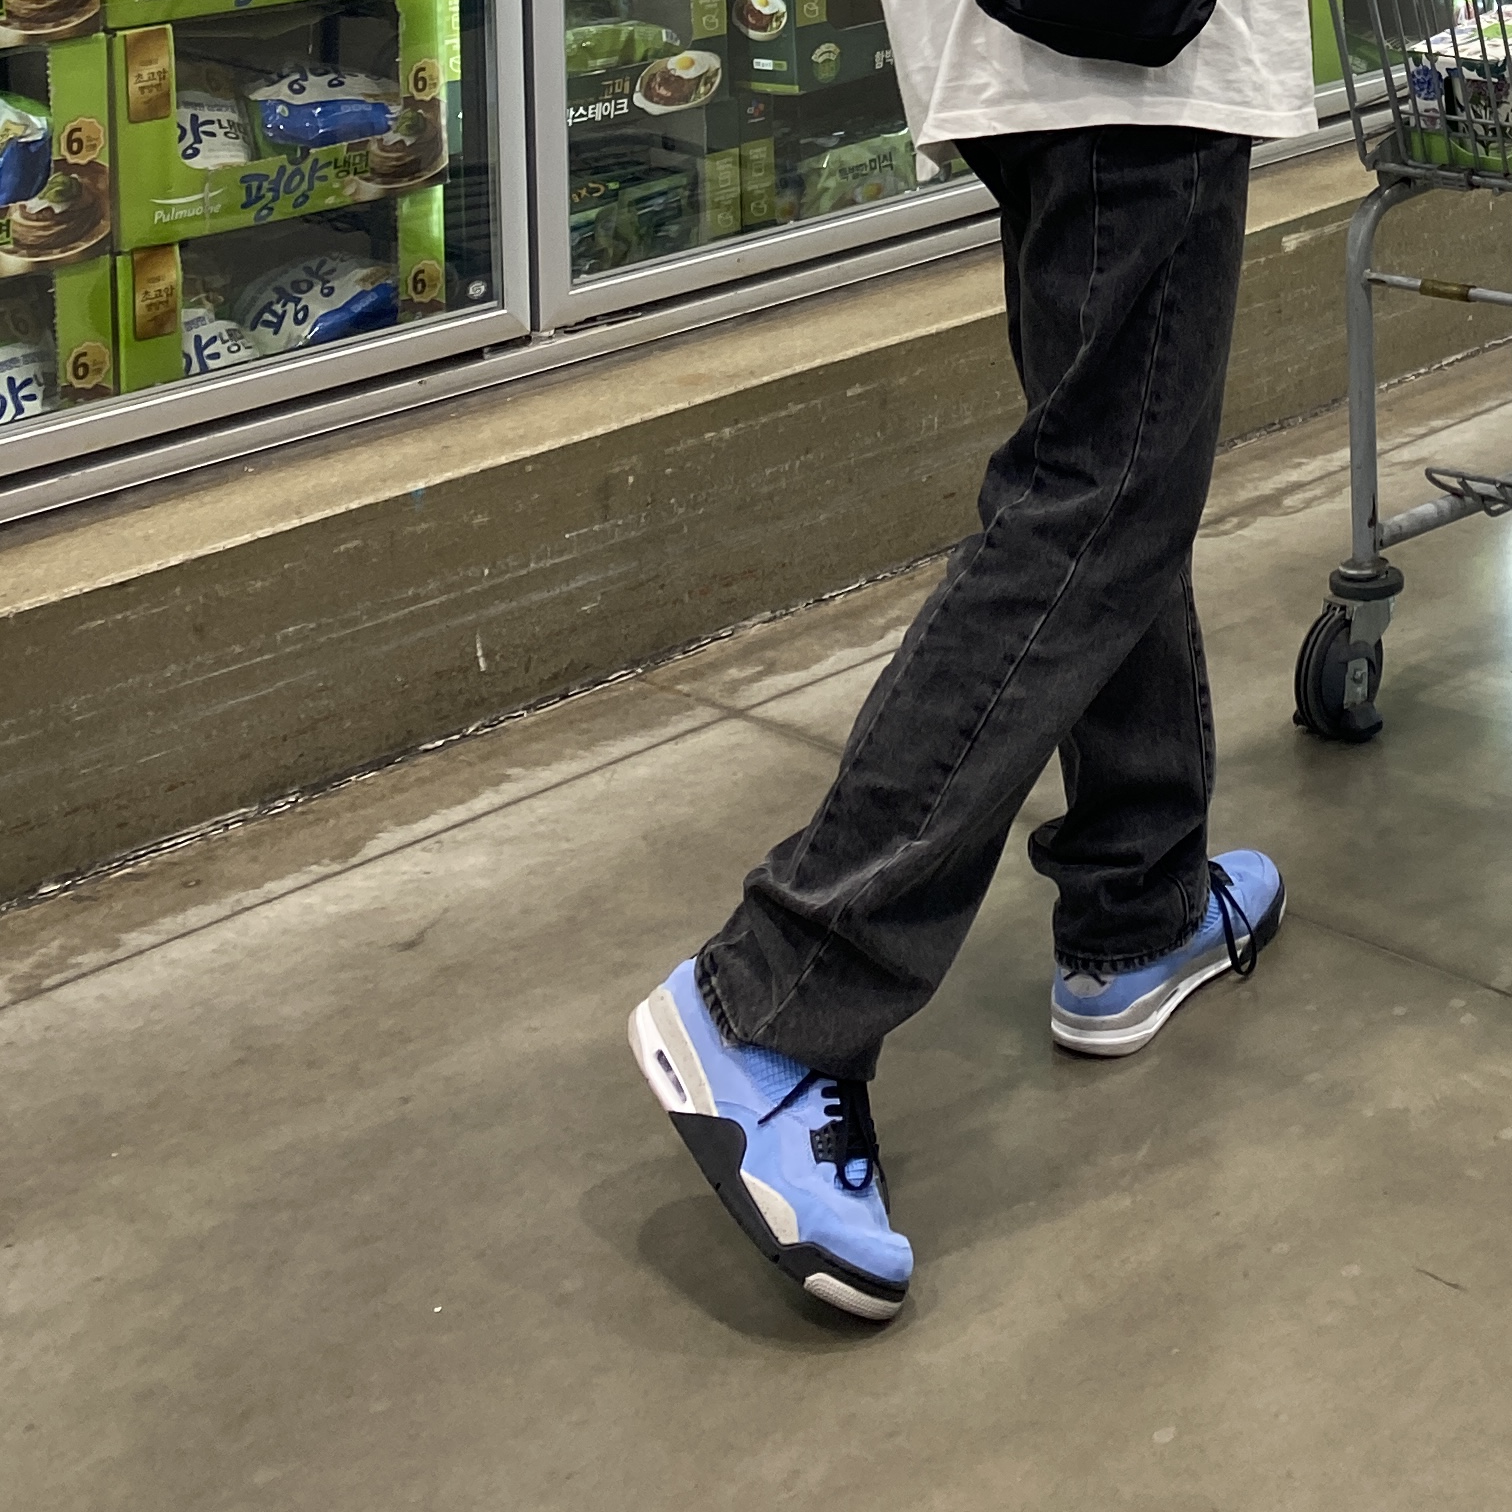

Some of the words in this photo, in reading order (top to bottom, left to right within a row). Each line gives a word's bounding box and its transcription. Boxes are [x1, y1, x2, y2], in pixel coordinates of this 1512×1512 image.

[411, 67, 428, 94] 6
[65, 127, 84, 155] 6
[154, 201, 222, 225] Pulmuone
[411, 269, 427, 294] 6
[72, 351, 90, 380] 6
